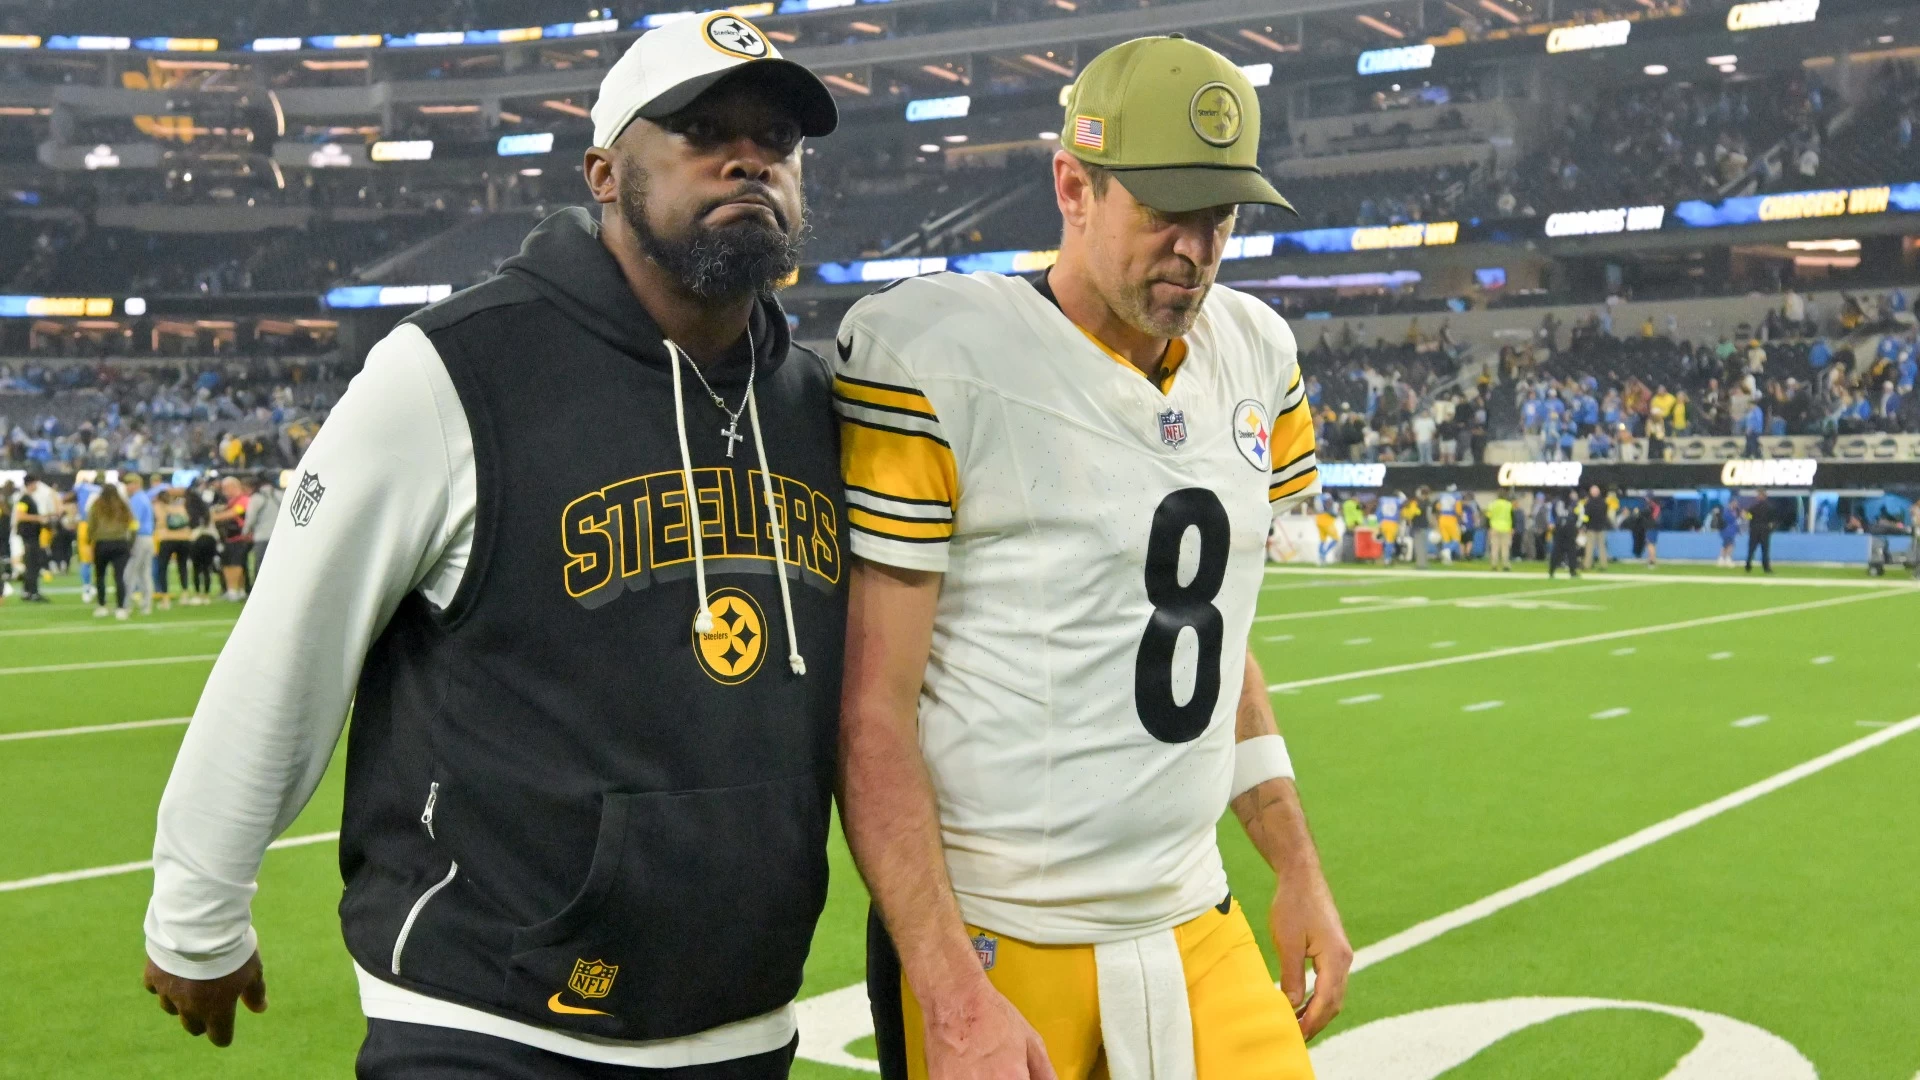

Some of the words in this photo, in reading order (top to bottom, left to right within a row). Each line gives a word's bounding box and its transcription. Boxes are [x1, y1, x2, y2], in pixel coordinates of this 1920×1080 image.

[712, 27, 740, 37] Steelers
[1848, 186, 1890, 214] WIN
[1626, 205, 1665, 231] WIN
[1164, 423, 1185, 441] NFL
[1238, 429, 1255, 439] Steelers
[293, 489, 314, 522] NFL
[561, 467, 841, 600] STEELERS
[1135, 487, 1231, 744] 8
[703, 631, 729, 641] Steelers
[573, 973, 605, 994] NFL
